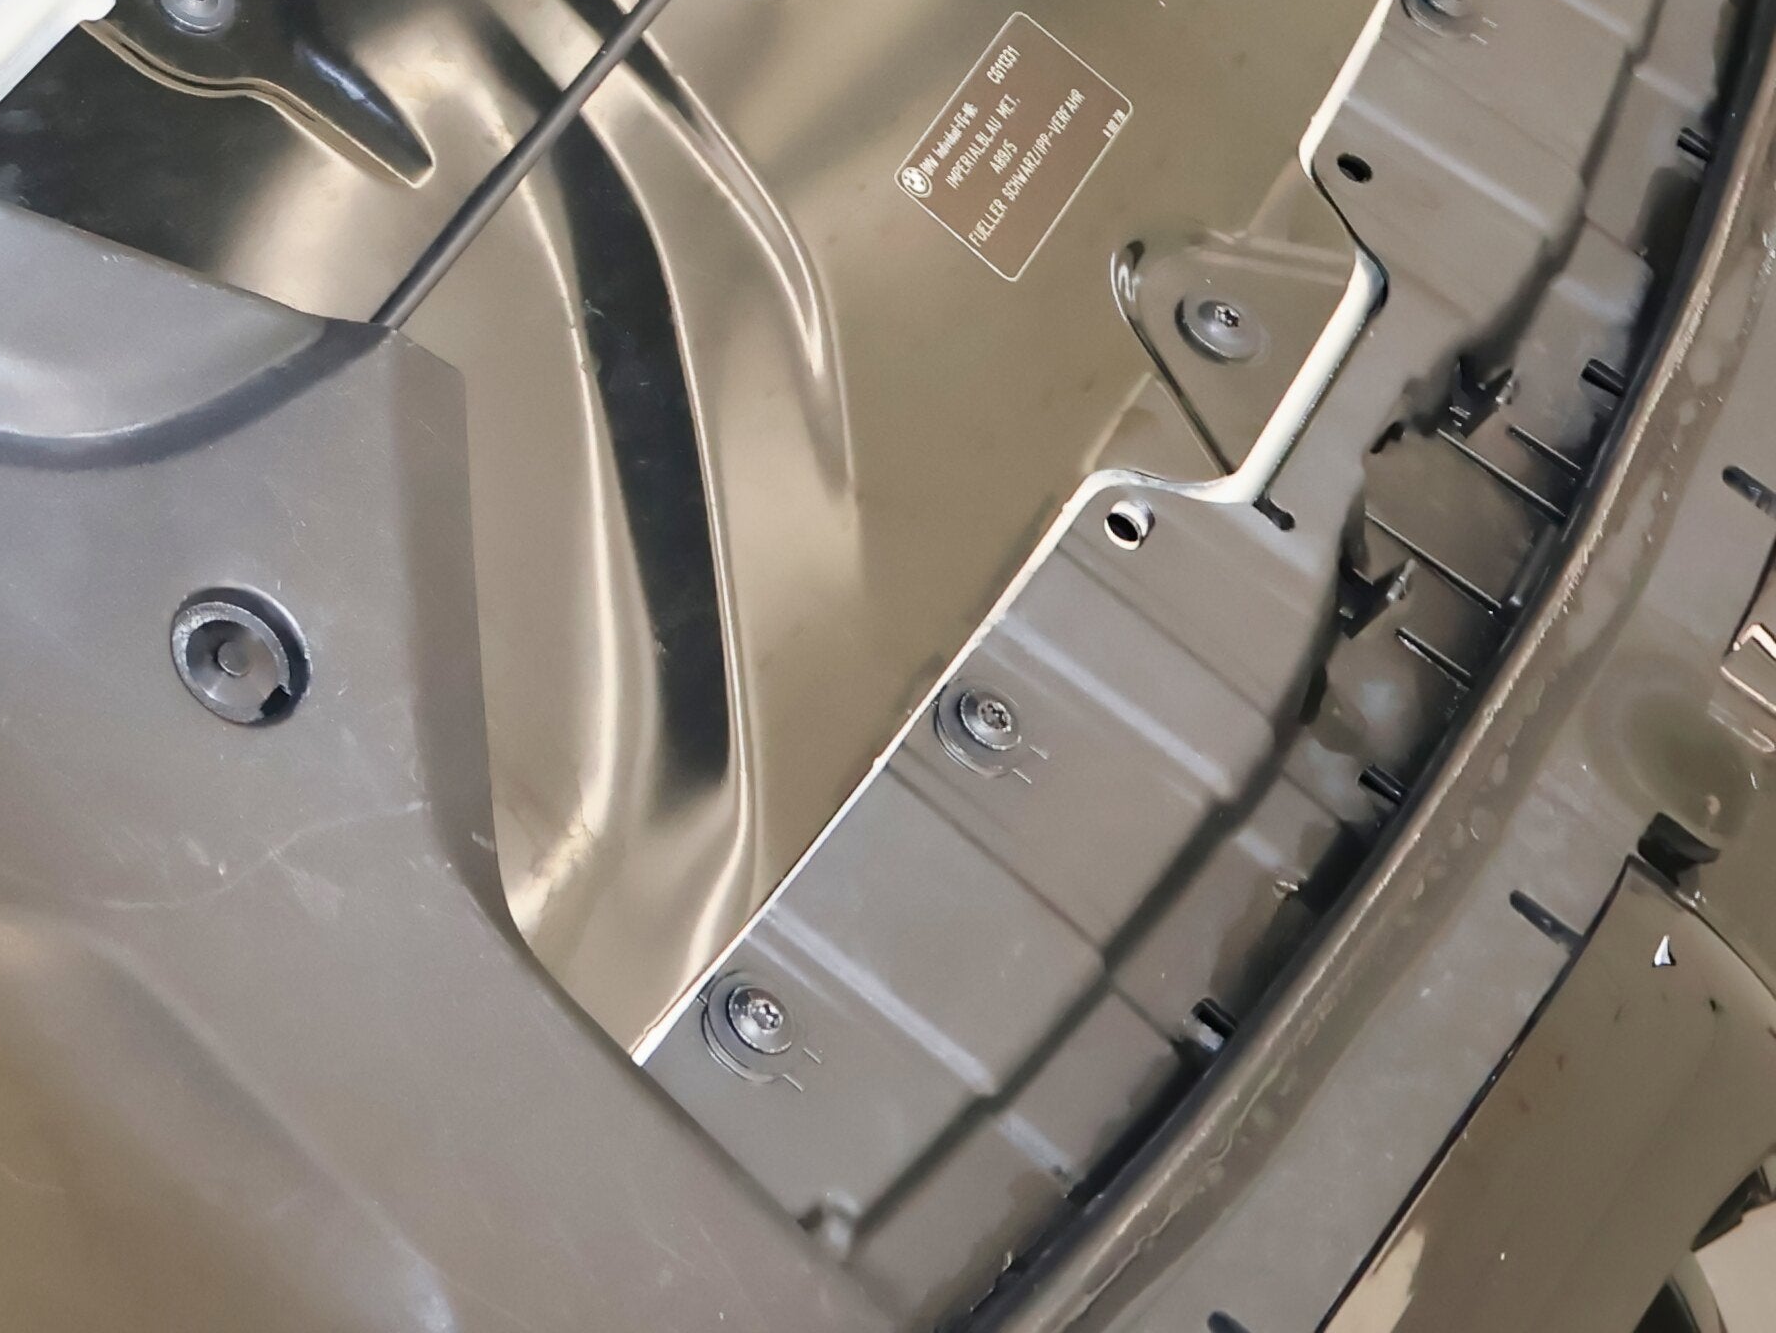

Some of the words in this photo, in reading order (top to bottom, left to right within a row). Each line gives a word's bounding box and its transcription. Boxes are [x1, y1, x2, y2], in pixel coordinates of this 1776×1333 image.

[944, 115, 1003, 190] IMPERIALBLAU
[995, 93, 1021, 121] MET.
[967, 197, 1008, 247] FUELLER
